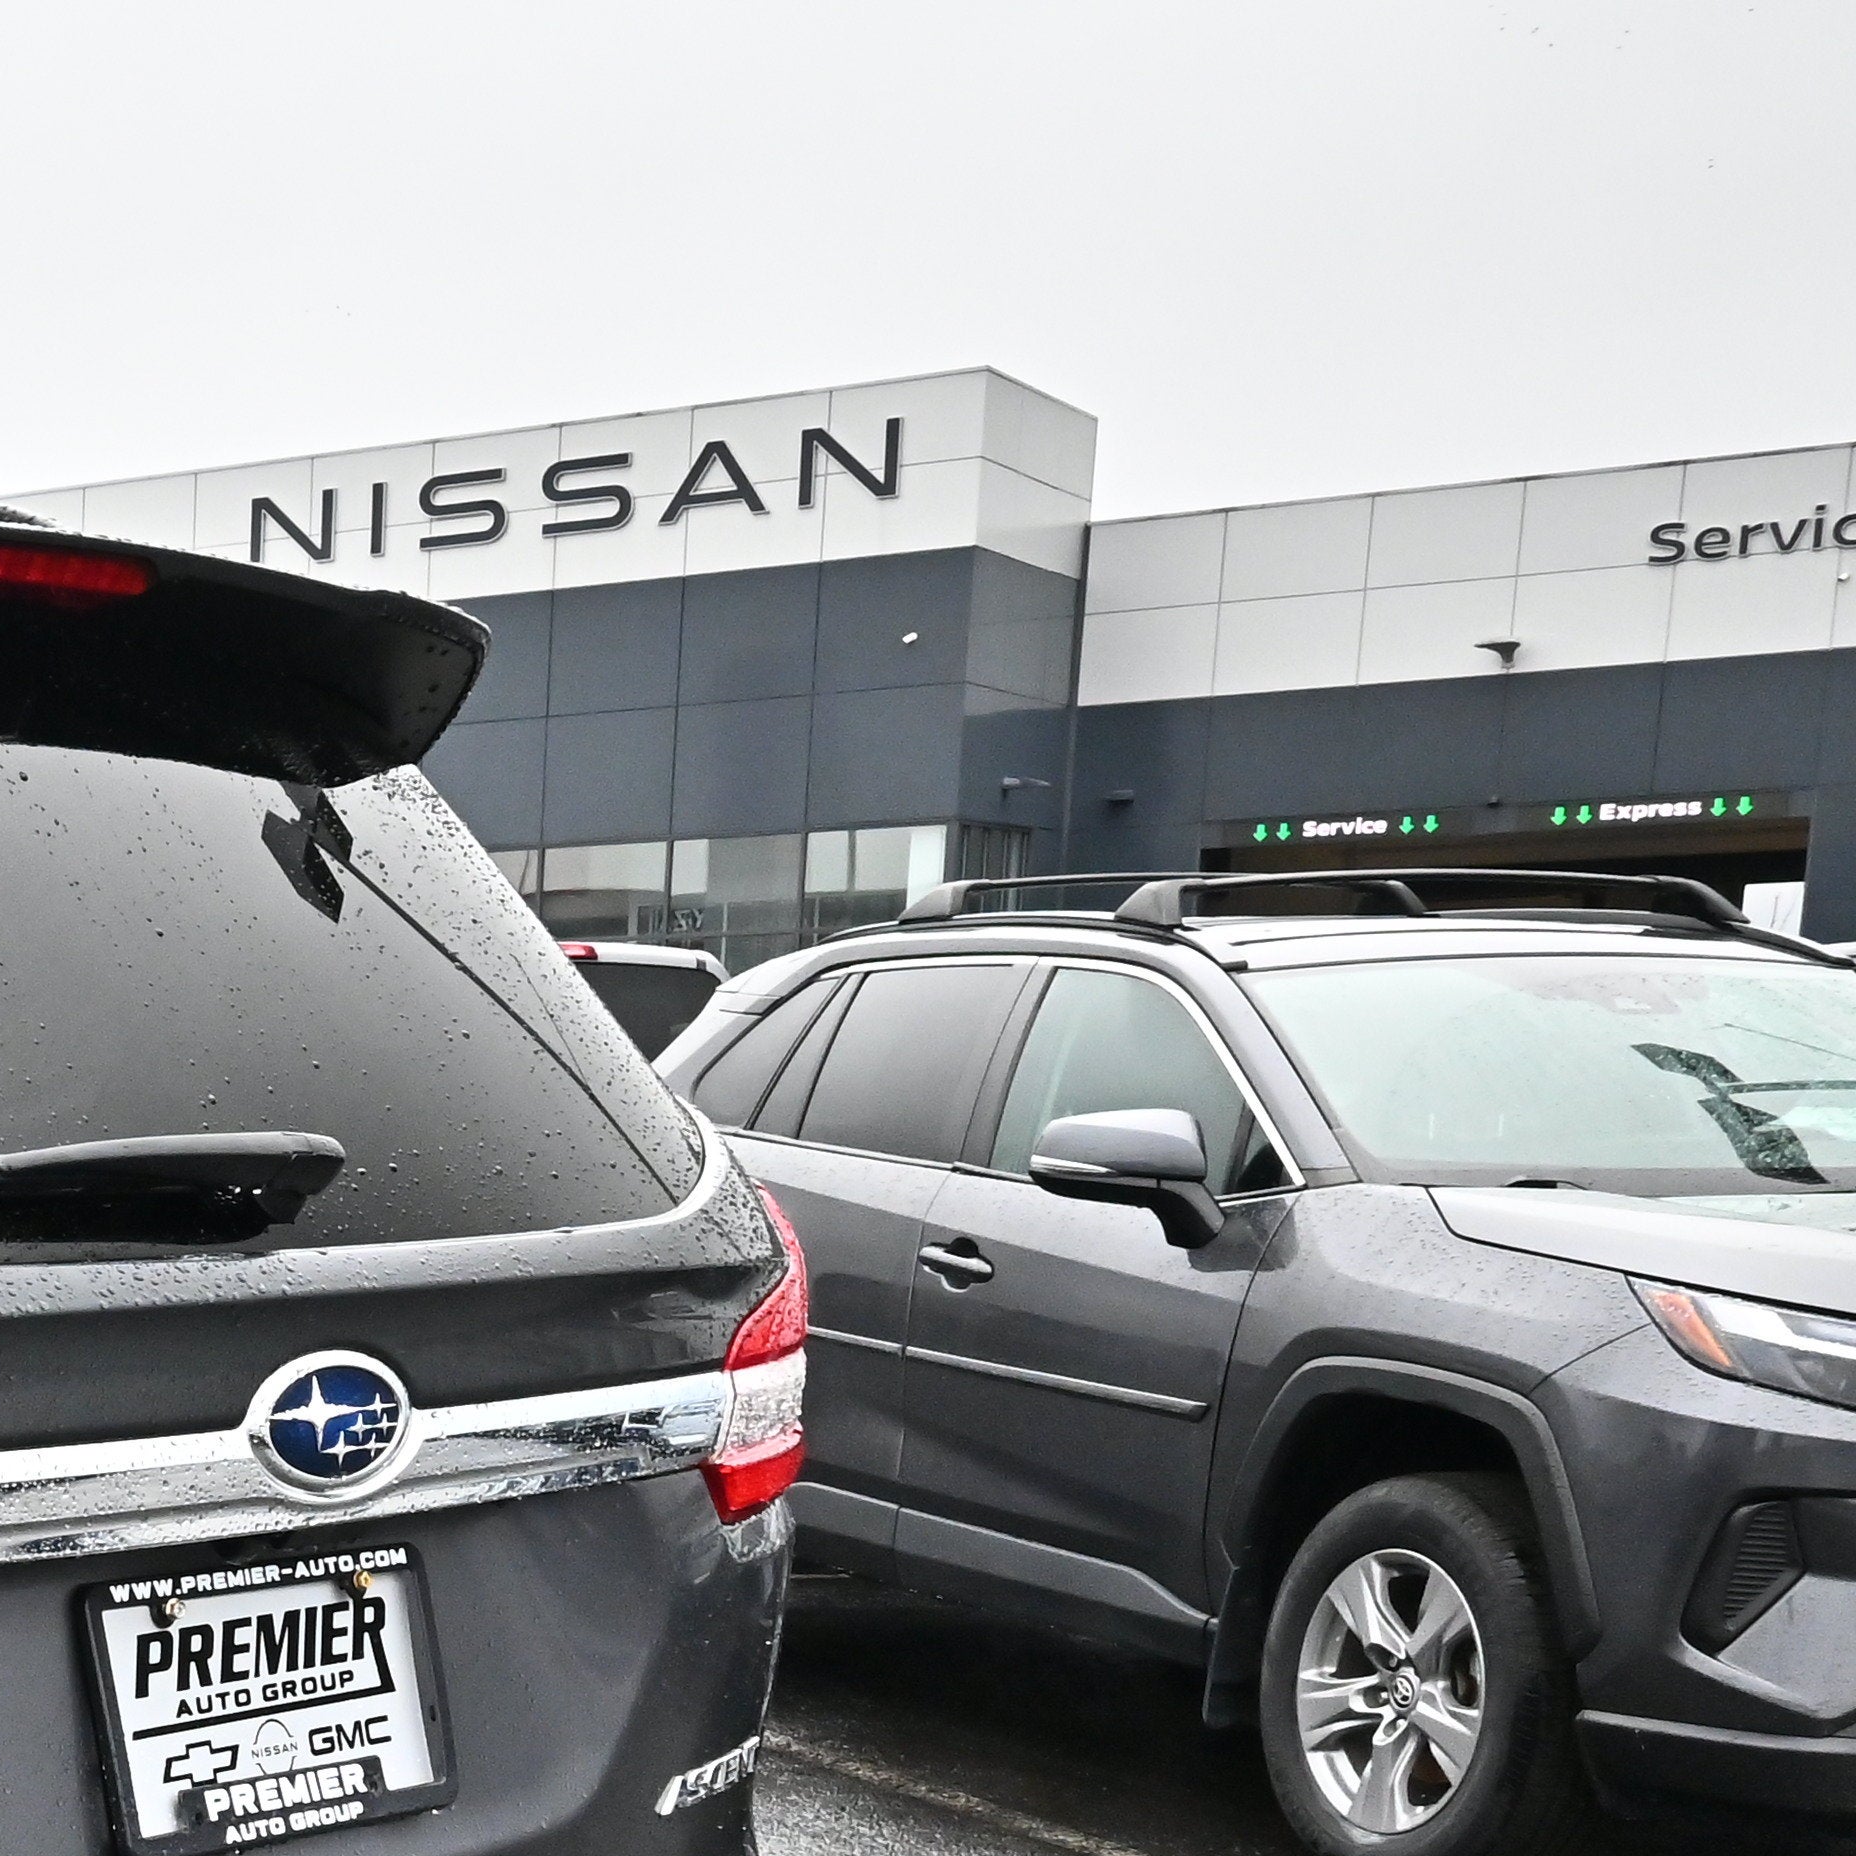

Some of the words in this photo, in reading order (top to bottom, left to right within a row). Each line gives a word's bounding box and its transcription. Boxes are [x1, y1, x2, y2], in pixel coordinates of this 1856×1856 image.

[249, 416, 904, 563] NISSAN
[1302, 817, 1388, 837] Service
[1599, 801, 1702, 822] Express
[110, 1548, 407, 1603] WWW.PREMIER-AUTO.COM
[134, 1597, 396, 1700] PREMIER
[176, 1687, 252, 1719] AUTO
[261, 1670, 354, 1701] GROUP
[251, 1742, 298, 1759] NISSAN
[308, 1715, 392, 1757] GMC
[204, 1763, 368, 1822] PREMIER
[225, 1818, 287, 1845] AUTO
[289, 1801, 364, 1832] GROUP
